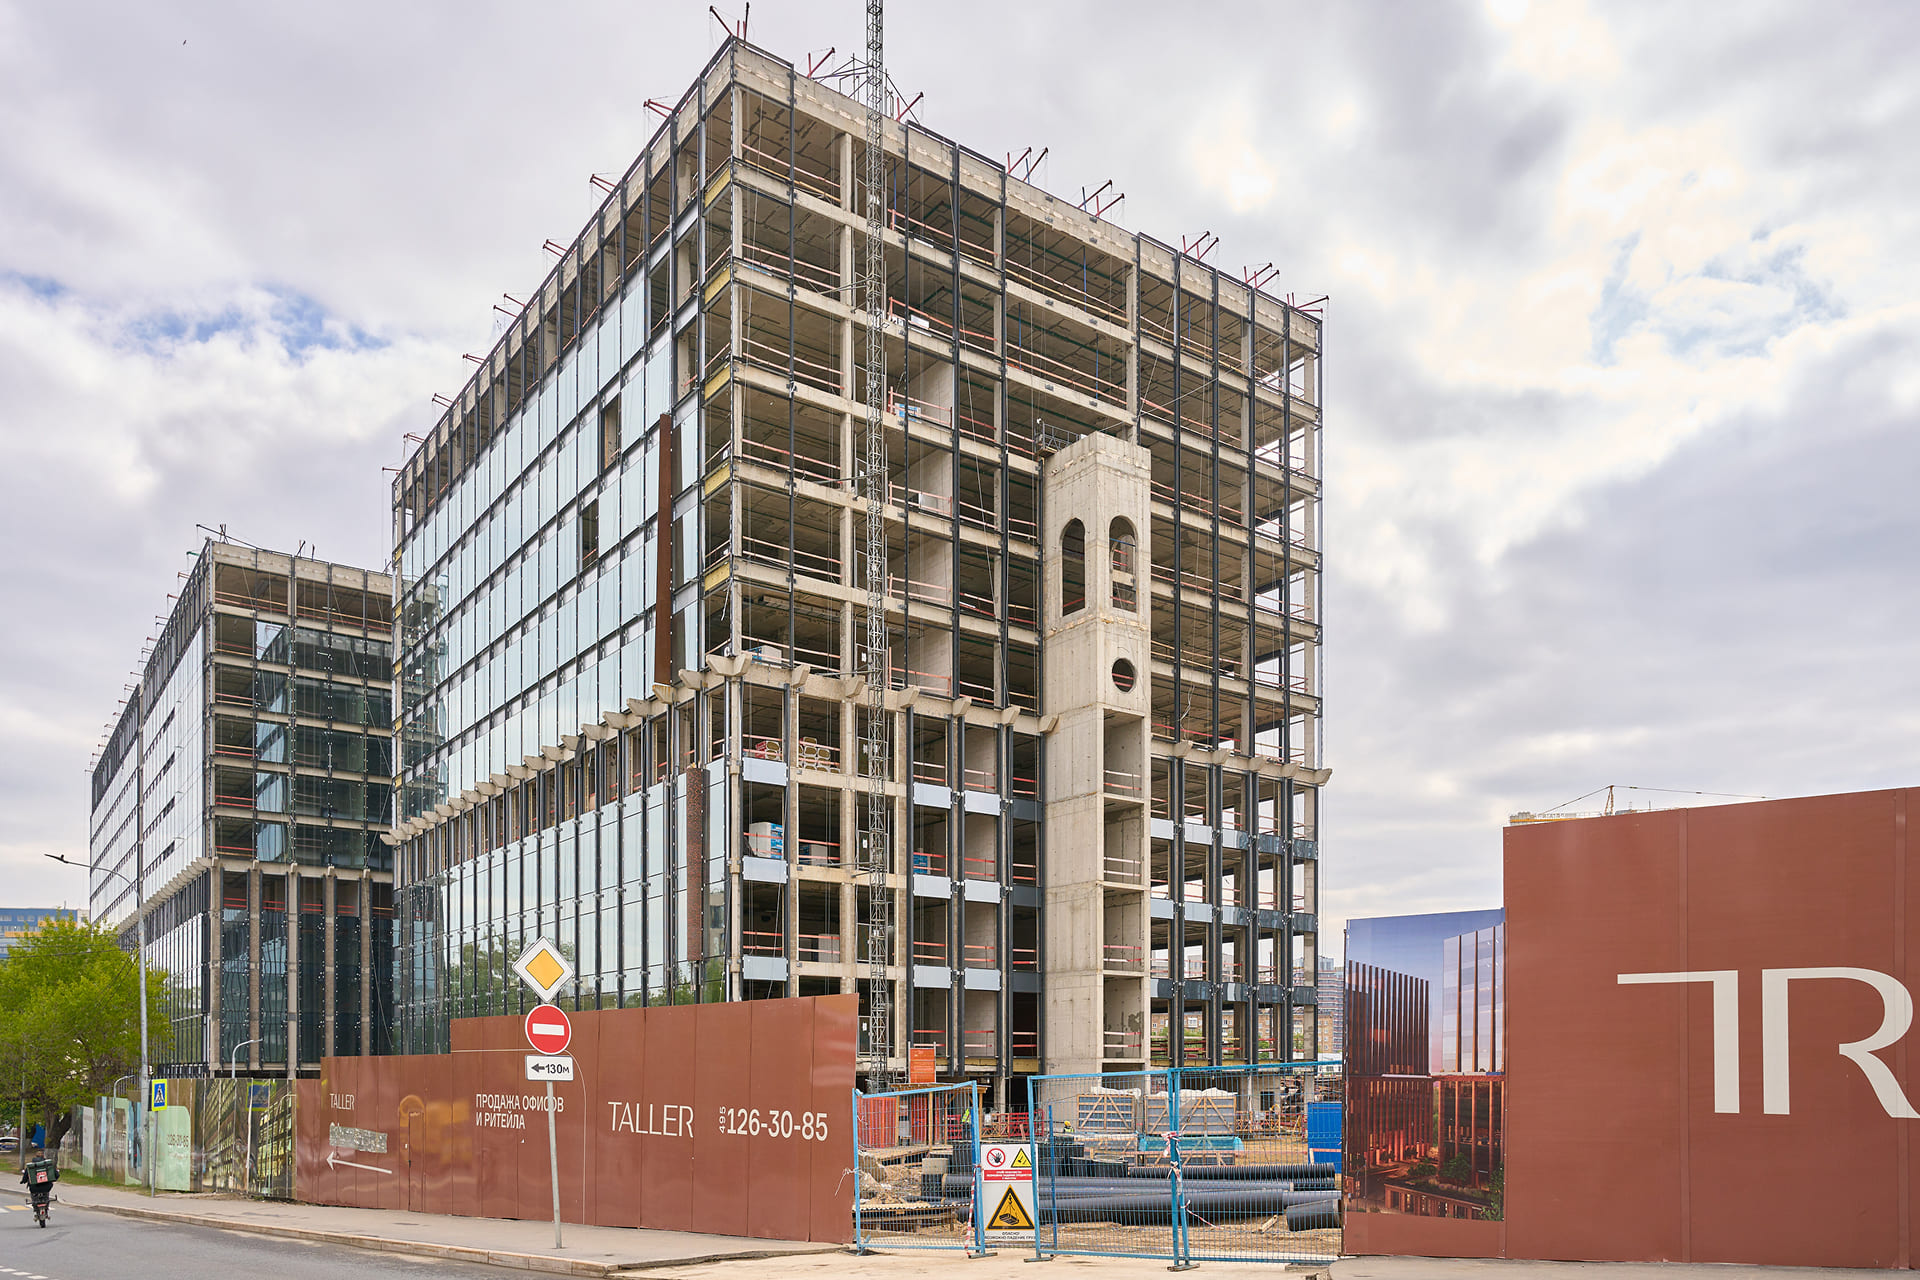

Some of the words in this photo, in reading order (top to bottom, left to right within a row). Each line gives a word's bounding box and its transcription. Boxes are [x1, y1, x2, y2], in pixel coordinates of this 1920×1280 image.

[329, 1093, 355, 1111] TALLER
[475, 1093, 521, 1112] ПРОДАЖА
[475, 1111, 483, 1127] И
[484, 1110, 526, 1130] РИТЕЙЛА
[607, 1101, 694, 1138] TALLER
[727, 1108, 828, 1142] 126-30-85
